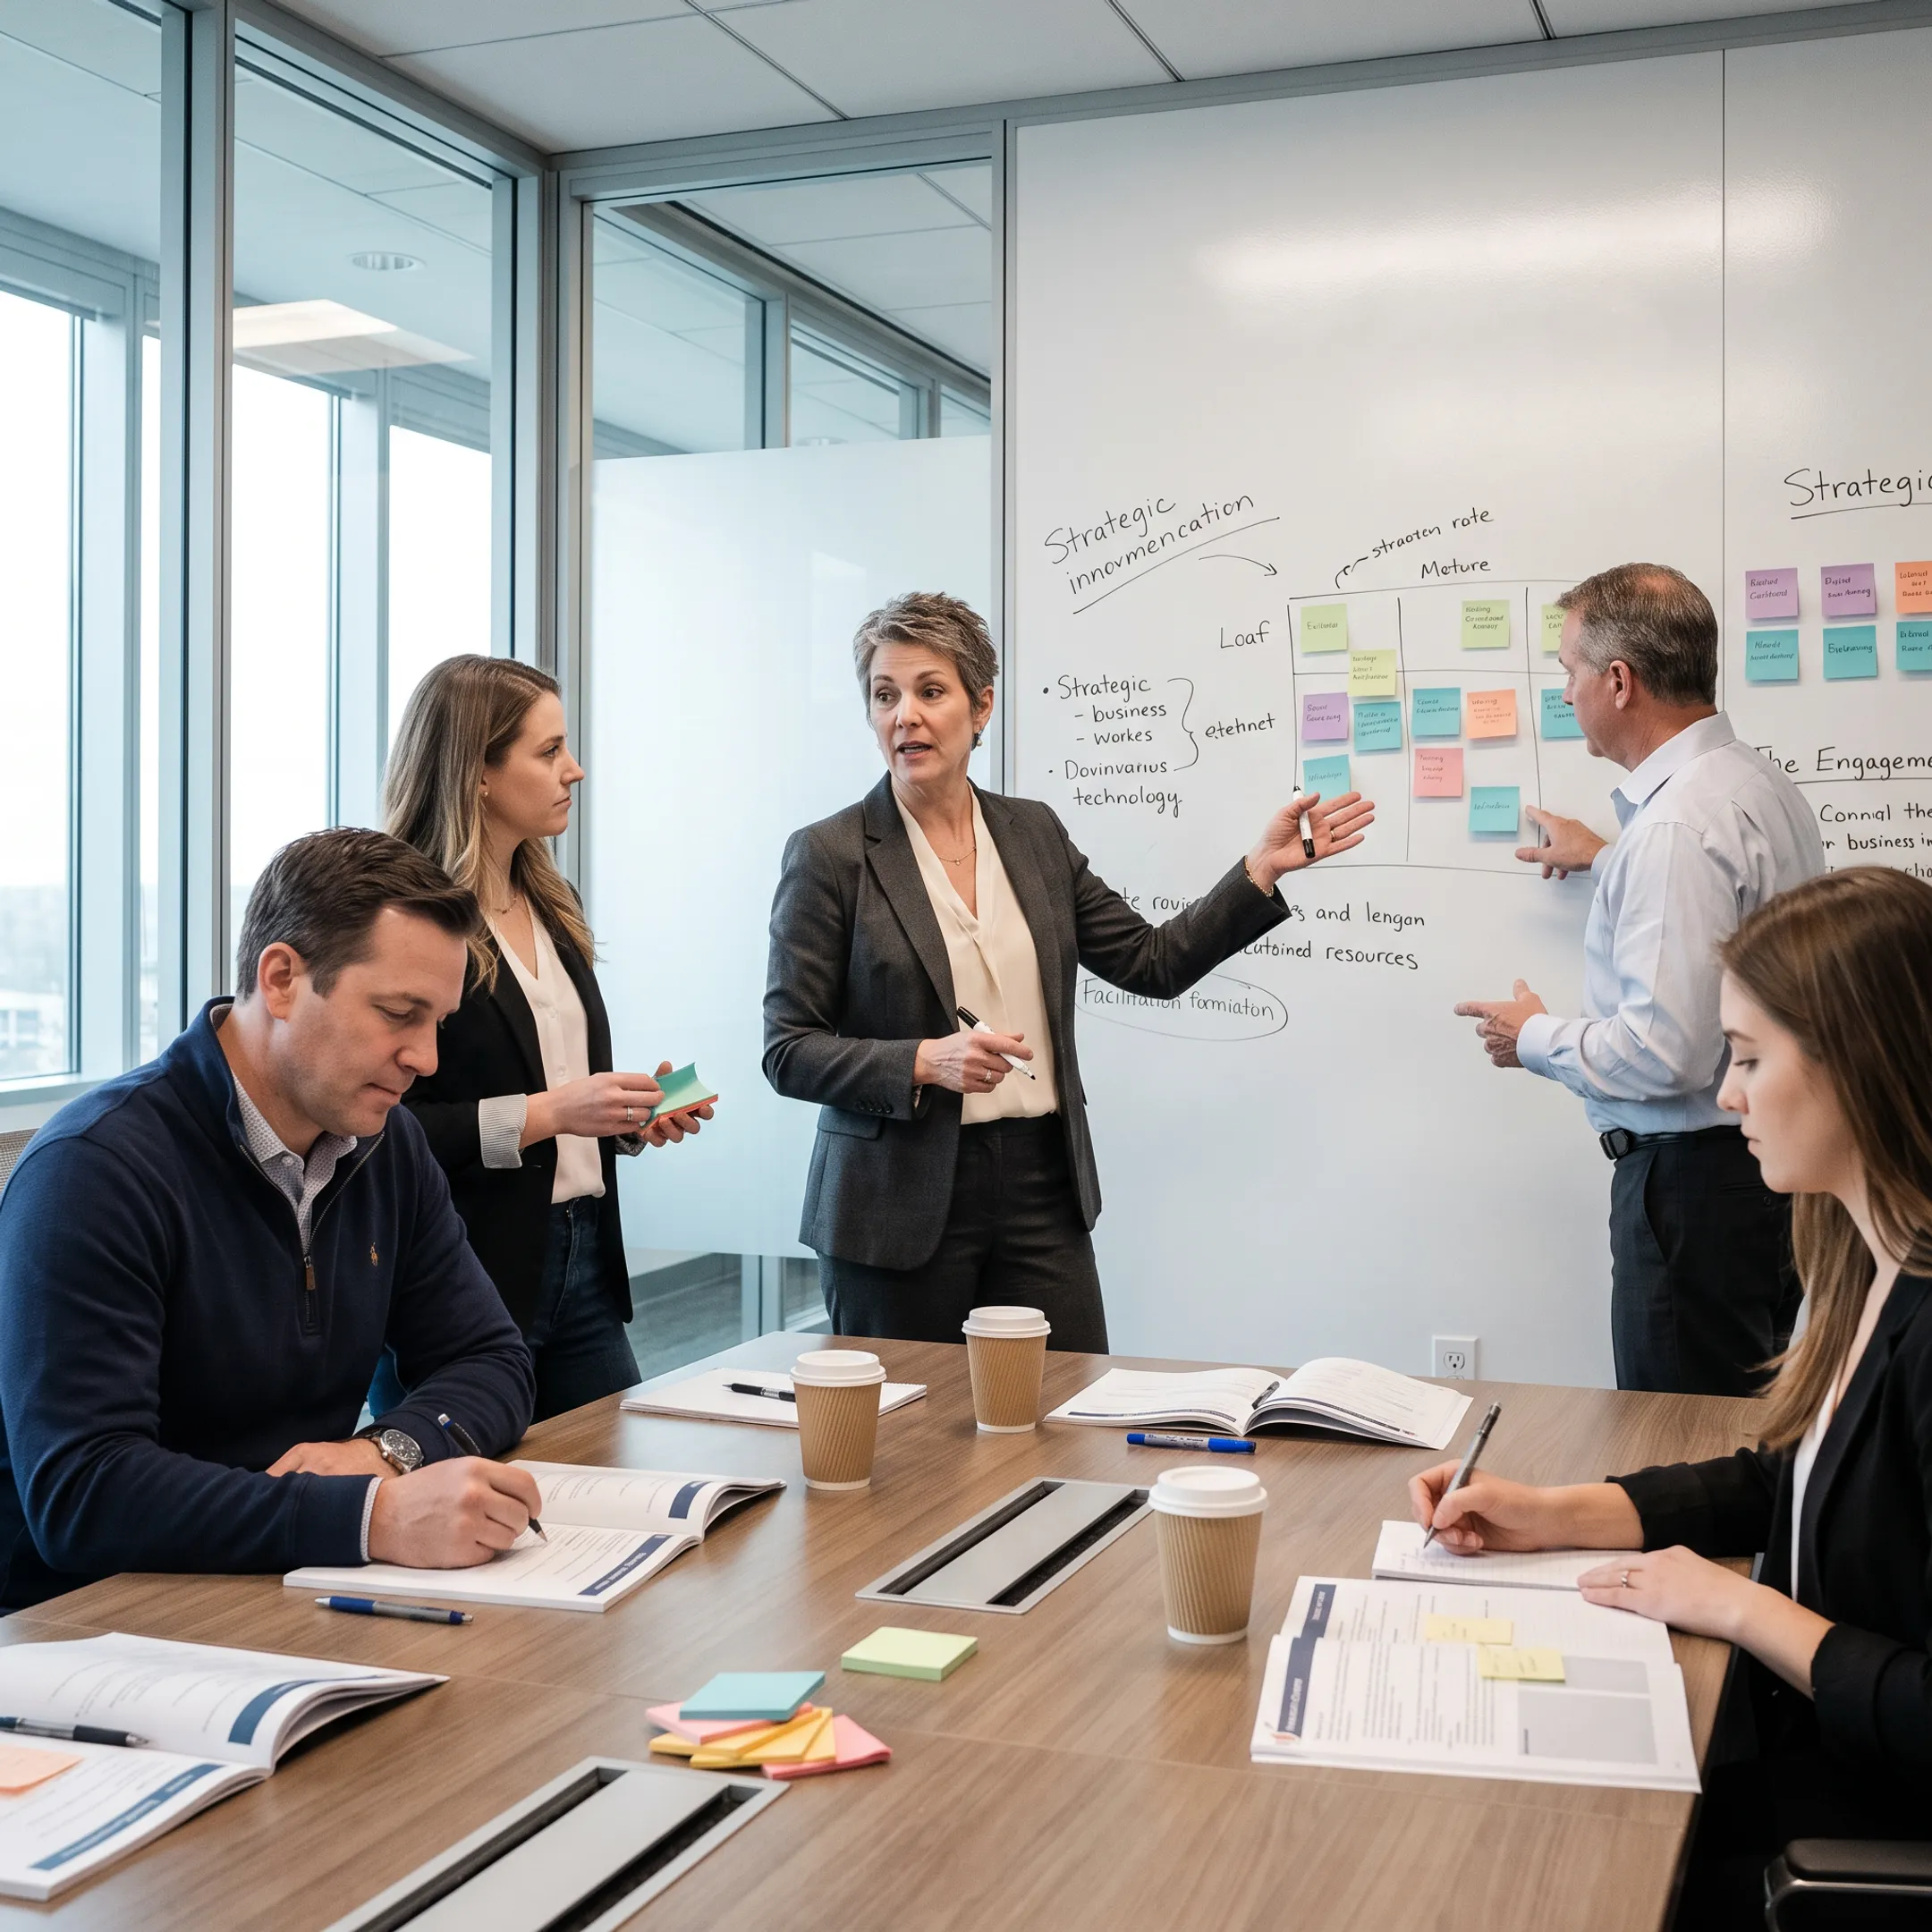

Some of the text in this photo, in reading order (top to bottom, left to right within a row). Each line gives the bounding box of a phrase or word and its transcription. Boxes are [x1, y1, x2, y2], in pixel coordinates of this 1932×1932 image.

[1045, 497, 1177, 564] Strategic
[1220, 620, 1272, 649] Loaf
[1057, 674, 1151, 702] Strategic
[1092, 704, 1167, 723] business
[1072, 785, 1183, 818] technology
[1847, 833, 1915, 851] business
[1121, 886, 1140, 911] te
[1316, 902, 1351, 922] and
[1326, 946, 1419, 970] resources
